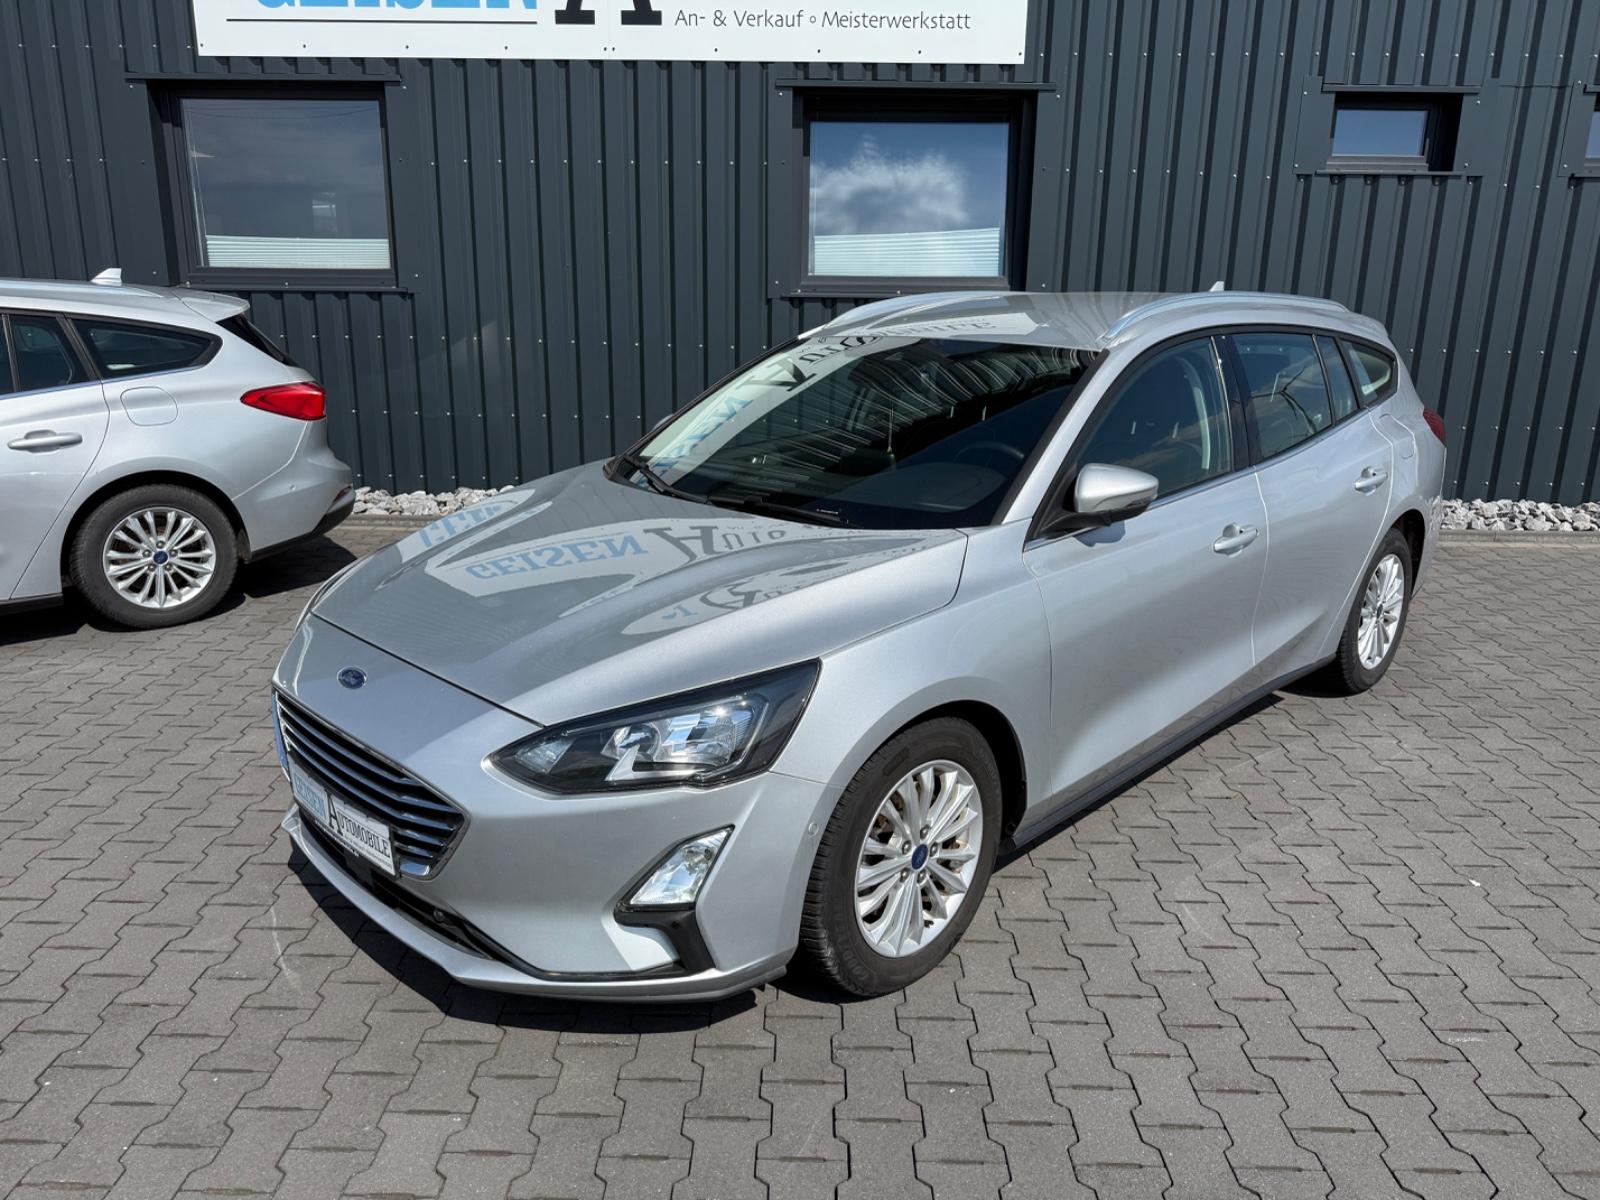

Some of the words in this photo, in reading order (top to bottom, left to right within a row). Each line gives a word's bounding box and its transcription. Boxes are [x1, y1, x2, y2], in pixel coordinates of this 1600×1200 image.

[674, 9, 706, 27] An-
[713, 9, 727, 27] &
[733, 9, 804, 28] Verkauf
[821, 10, 971, 29] Meisterwerkstatt
